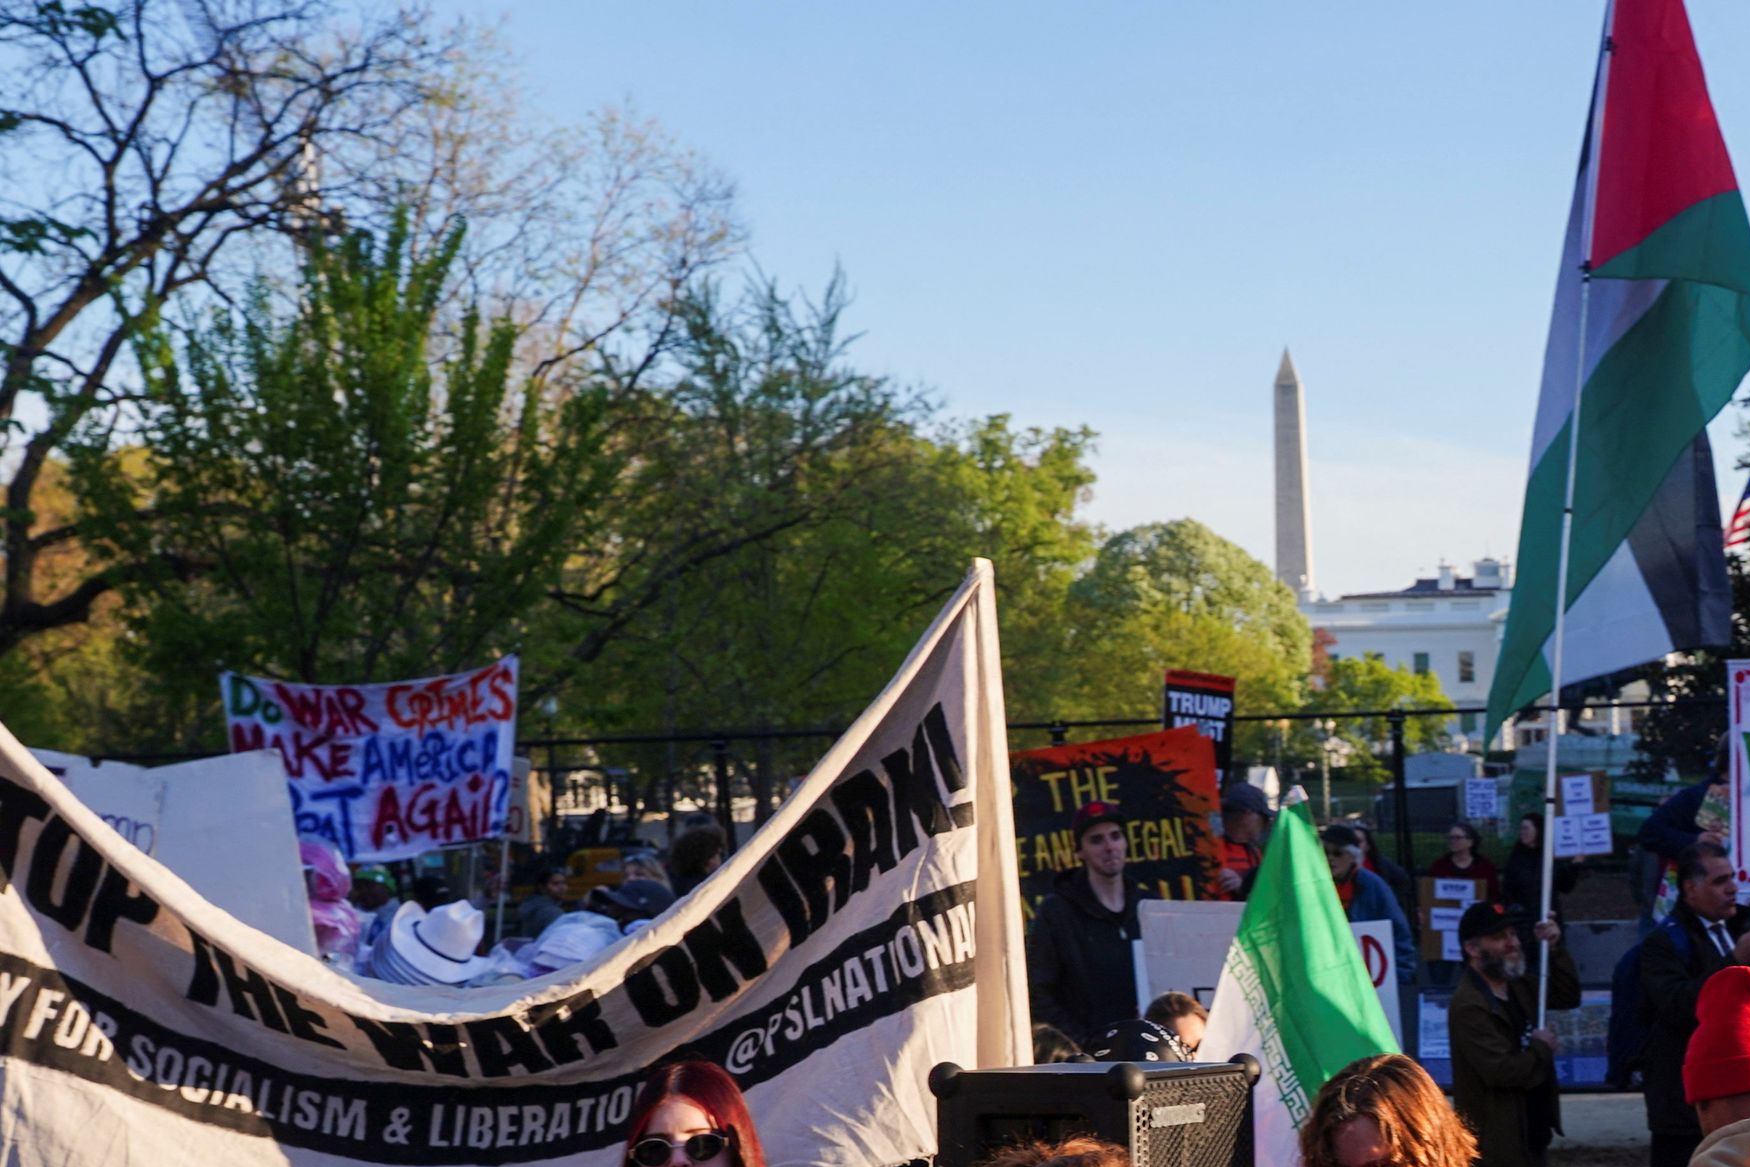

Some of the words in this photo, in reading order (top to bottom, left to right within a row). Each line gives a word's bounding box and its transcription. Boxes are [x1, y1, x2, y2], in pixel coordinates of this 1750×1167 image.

[230, 676, 282, 724] Do
[274, 683, 378, 737] WAR
[386, 664, 513, 739] CRIMES
[1168, 690, 1231, 718] TRUMP
[1040, 766, 1121, 813] THE
[342, 988, 620, 1079] WAR
[625, 896, 768, 1028] ON
[757, 702, 975, 950] IRAN!
[24, 988, 119, 1062] FOR
[127, 1034, 367, 1141] SOCIALISM
[383, 1107, 413, 1145] &
